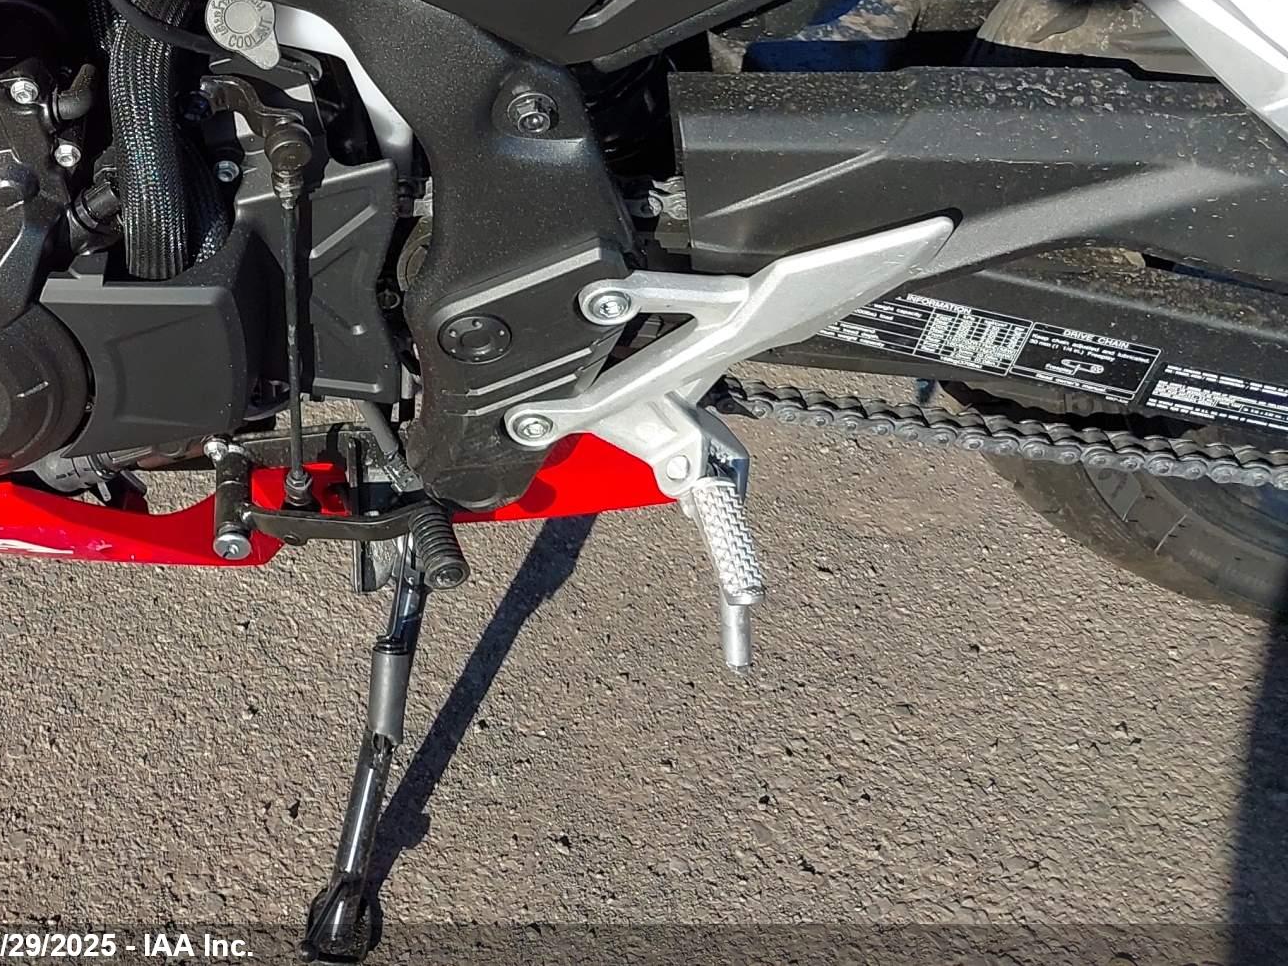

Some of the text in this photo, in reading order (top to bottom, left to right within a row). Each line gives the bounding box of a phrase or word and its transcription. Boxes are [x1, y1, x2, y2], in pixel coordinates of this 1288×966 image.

[228, 15, 273, 49] COOLANT
[906, 293, 972, 314] INFORMATION
[1032, 334, 1049, 342] Keep
[1051, 338, 1070, 346] chain
[1072, 342, 1100, 353] adjusted
[1101, 348, 1115, 356] and
[1063, 328, 1129, 349] DRIVE CHAIN
